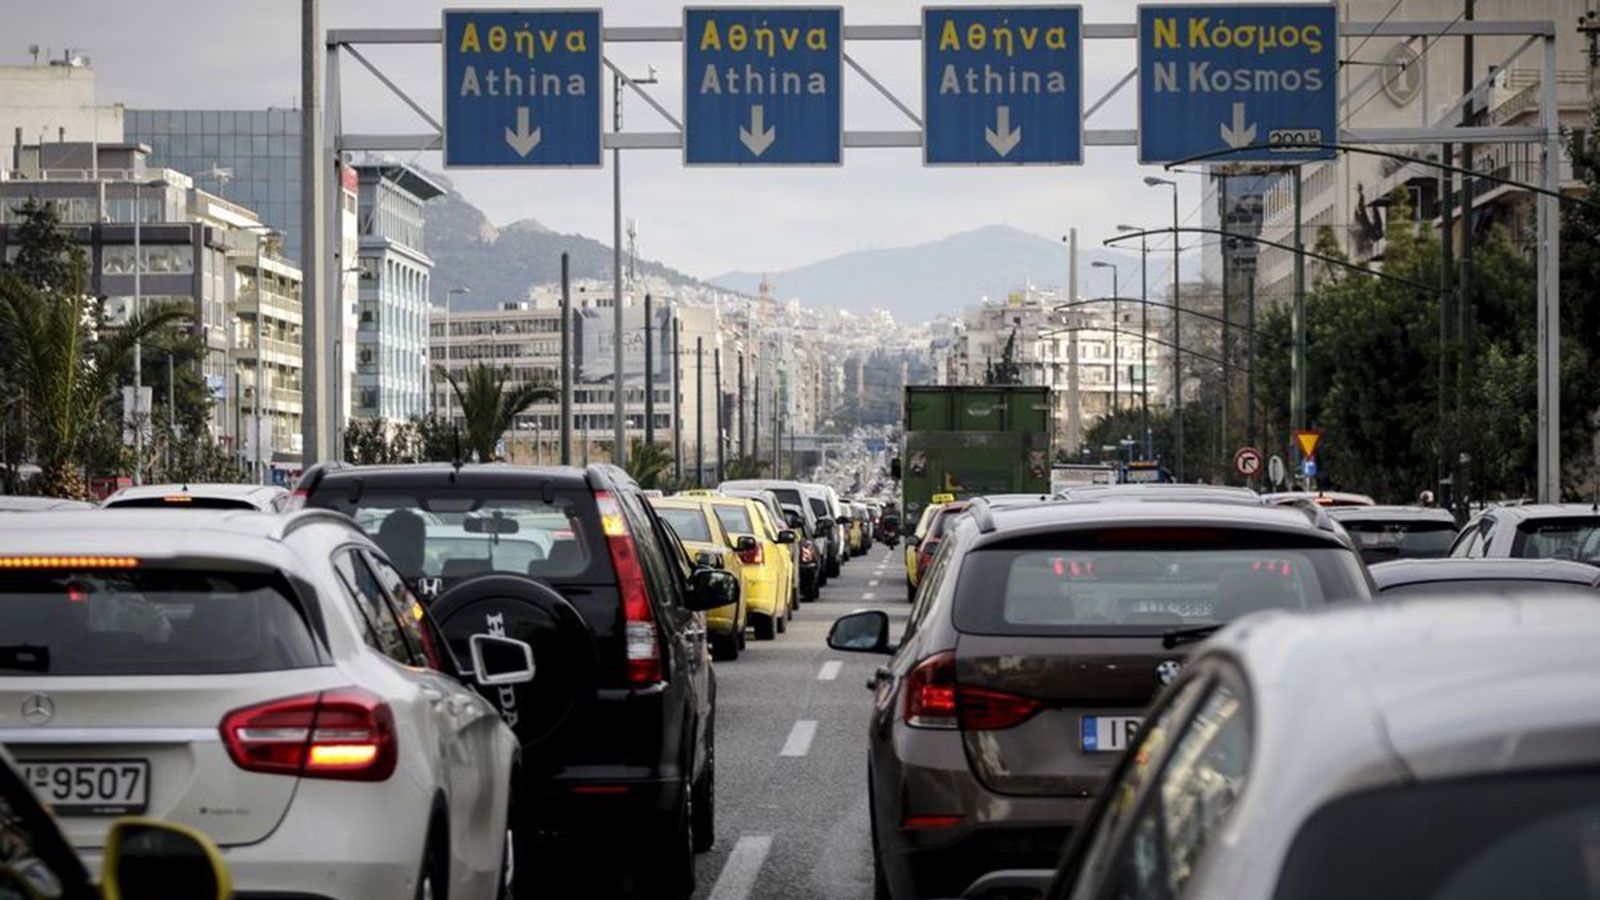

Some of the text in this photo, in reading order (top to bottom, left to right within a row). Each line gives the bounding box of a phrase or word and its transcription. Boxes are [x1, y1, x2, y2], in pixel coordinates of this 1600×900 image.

[461, 22, 586, 59] Αθήνα
[701, 19, 827, 57] Αθήνα
[939, 18, 1066, 57] Αθήνα
[1189, 18, 1322, 54] Κόσμος
[461, 66, 586, 97] Athina
[701, 64, 827, 95] Athina
[940, 64, 1066, 95] Athina
[1189, 62, 1322, 92] Kosmos
